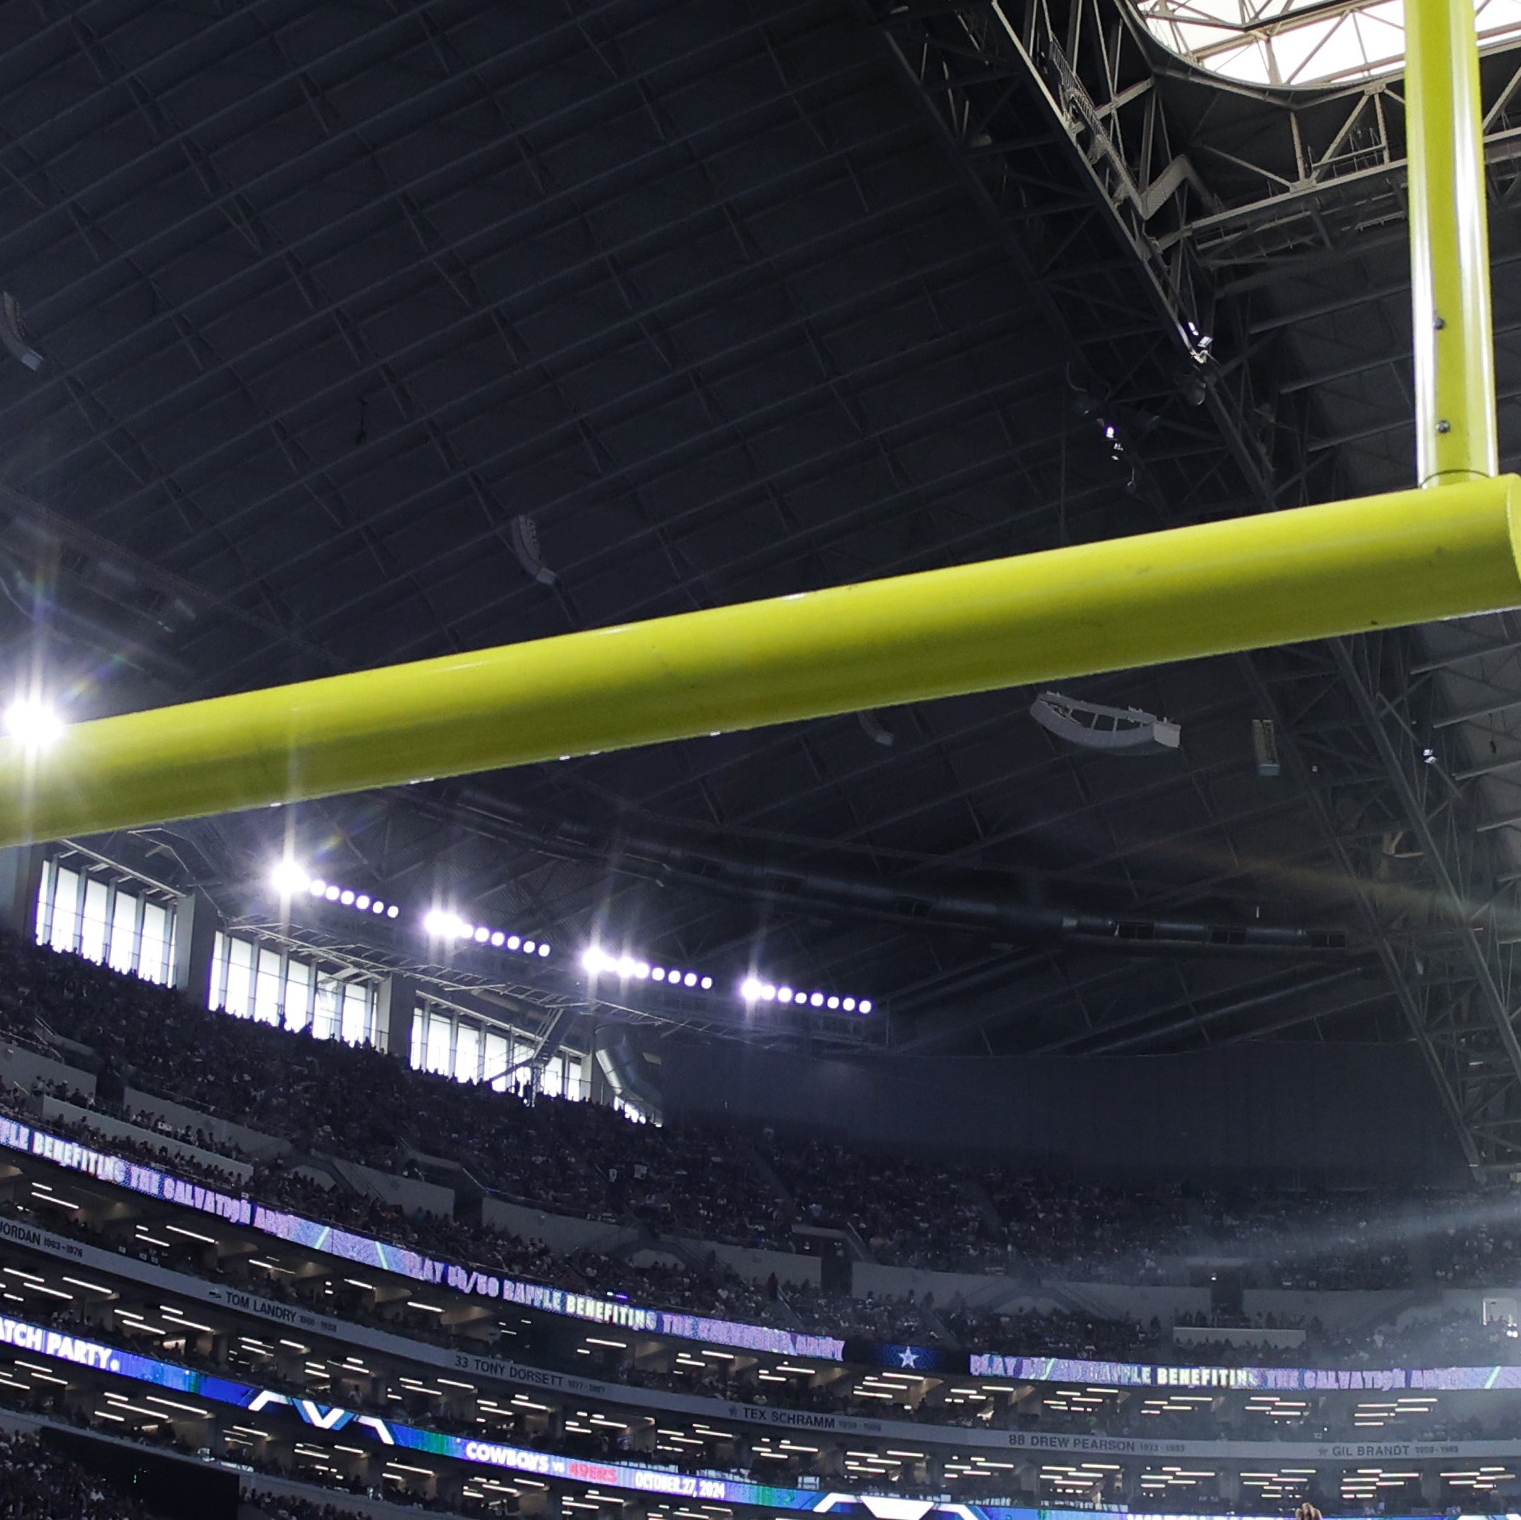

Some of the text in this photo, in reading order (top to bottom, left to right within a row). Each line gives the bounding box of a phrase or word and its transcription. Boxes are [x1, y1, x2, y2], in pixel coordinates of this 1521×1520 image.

[32, 1130, 127, 1188] BENEFITING
[225, 1290, 298, 1324] TOM LANDRY
[564, 1294, 659, 1332] BENEFITING
[45, 1327, 121, 1373] PARTY.
[454, 1355, 565, 1385] 33 TONY DORSETT
[1156, 1365, 1259, 1390] BENEFITING
[742, 1407, 768, 1421] TEX
[770, 1409, 836, 1430] SCHRAMM
[1008, 1433, 1136, 1452] 88 DREW PEARSON
[1331, 1446, 1353, 1457] GIL
[1356, 1444, 1411, 1457] BRANDT
[465, 1441, 550, 1473] COWBOYS
[568, 1460, 618, 1484] 49ERS
[700, 1479, 726, 1499] 2024
